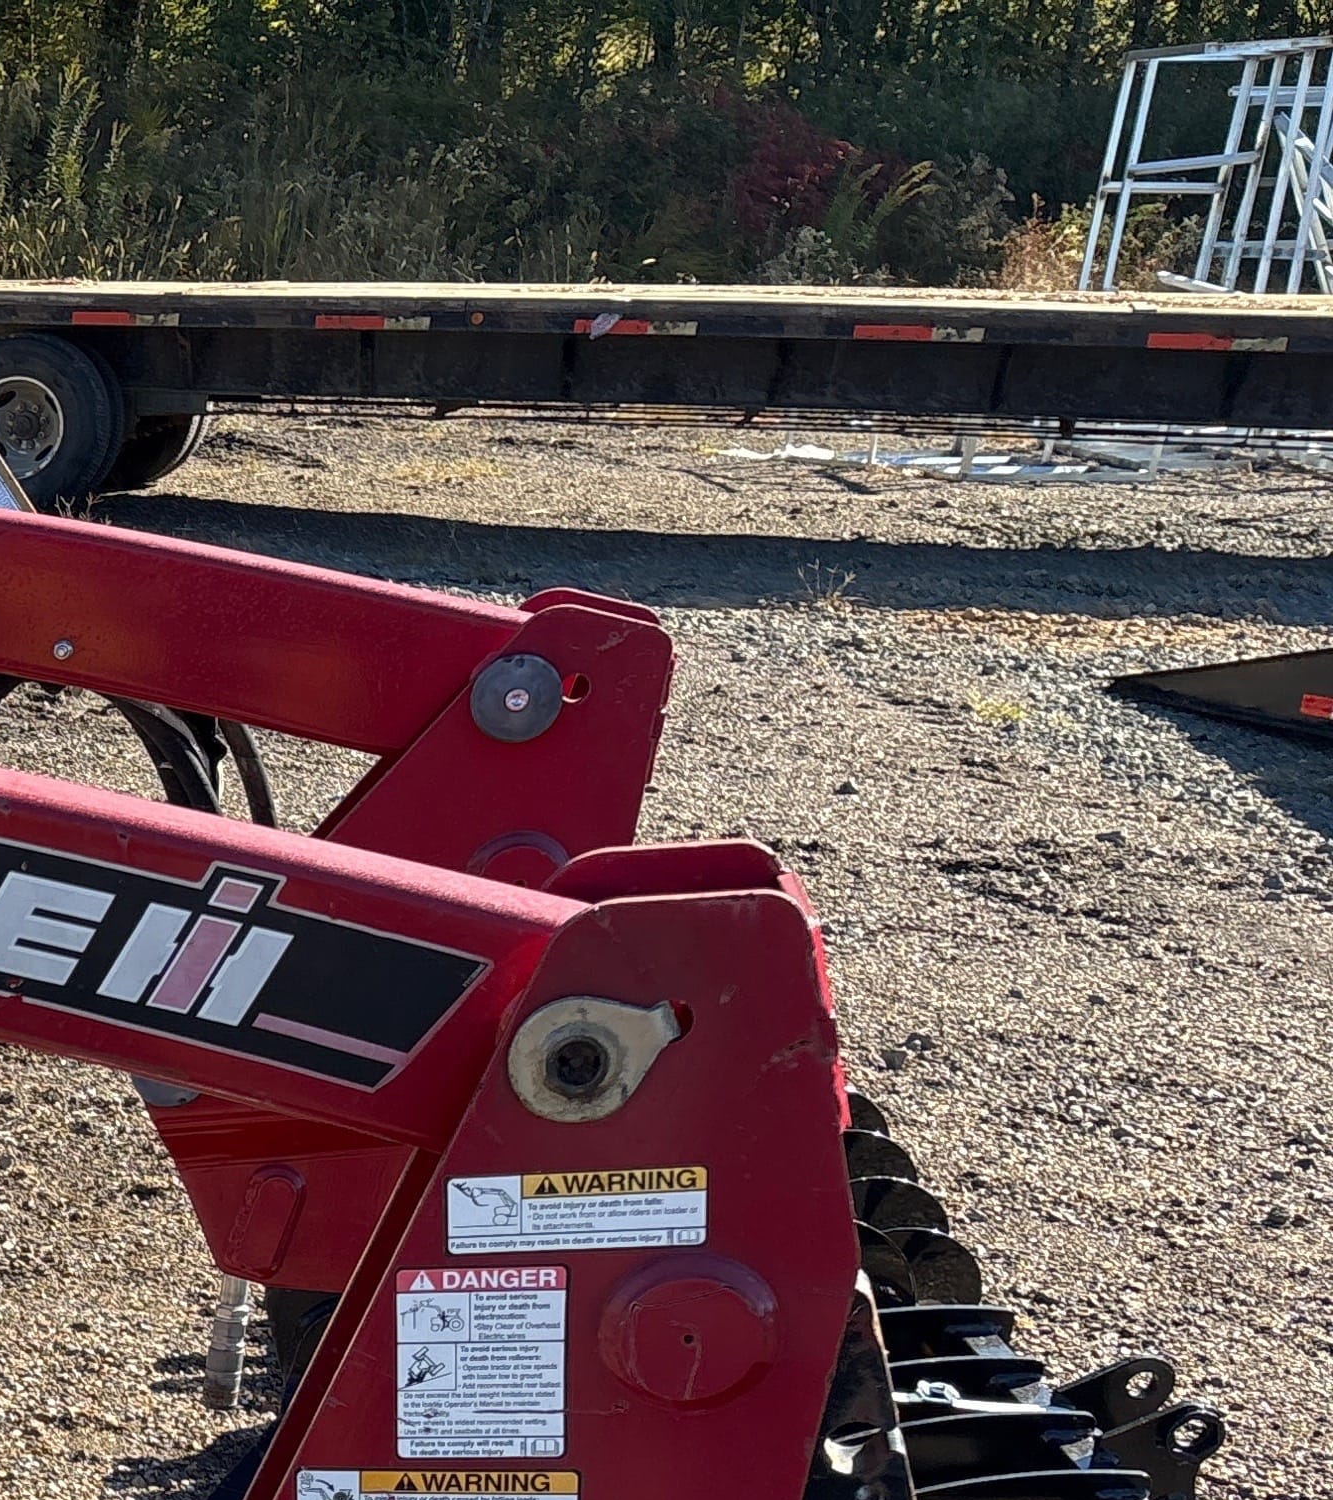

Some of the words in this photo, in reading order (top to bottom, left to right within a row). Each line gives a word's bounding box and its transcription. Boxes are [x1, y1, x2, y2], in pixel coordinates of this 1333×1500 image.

[562, 1169, 698, 1195] WARNING
[442, 1269, 557, 1289] DANGER
[422, 1473, 551, 1492] WARNING
